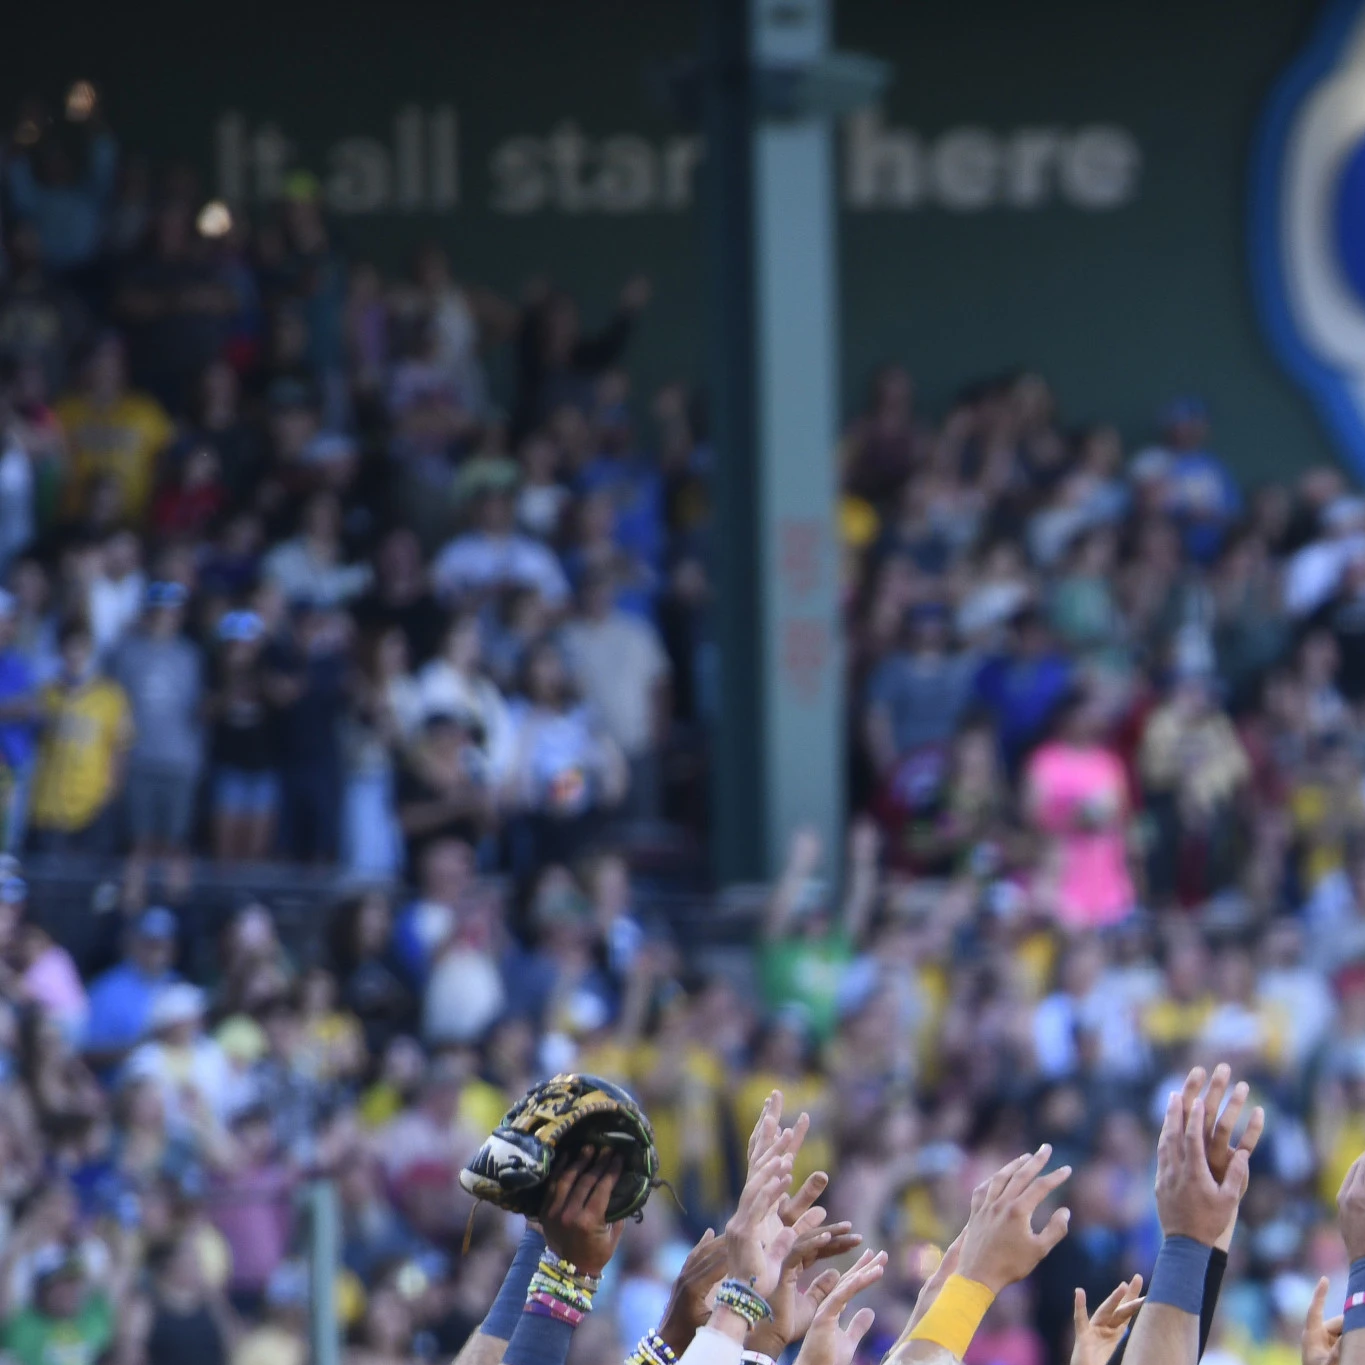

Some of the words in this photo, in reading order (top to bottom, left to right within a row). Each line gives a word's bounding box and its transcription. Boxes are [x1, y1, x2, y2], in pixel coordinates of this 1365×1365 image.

[325, 102, 460, 213] all
[490, 118, 704, 214] star
[845, 105, 1140, 212] here
